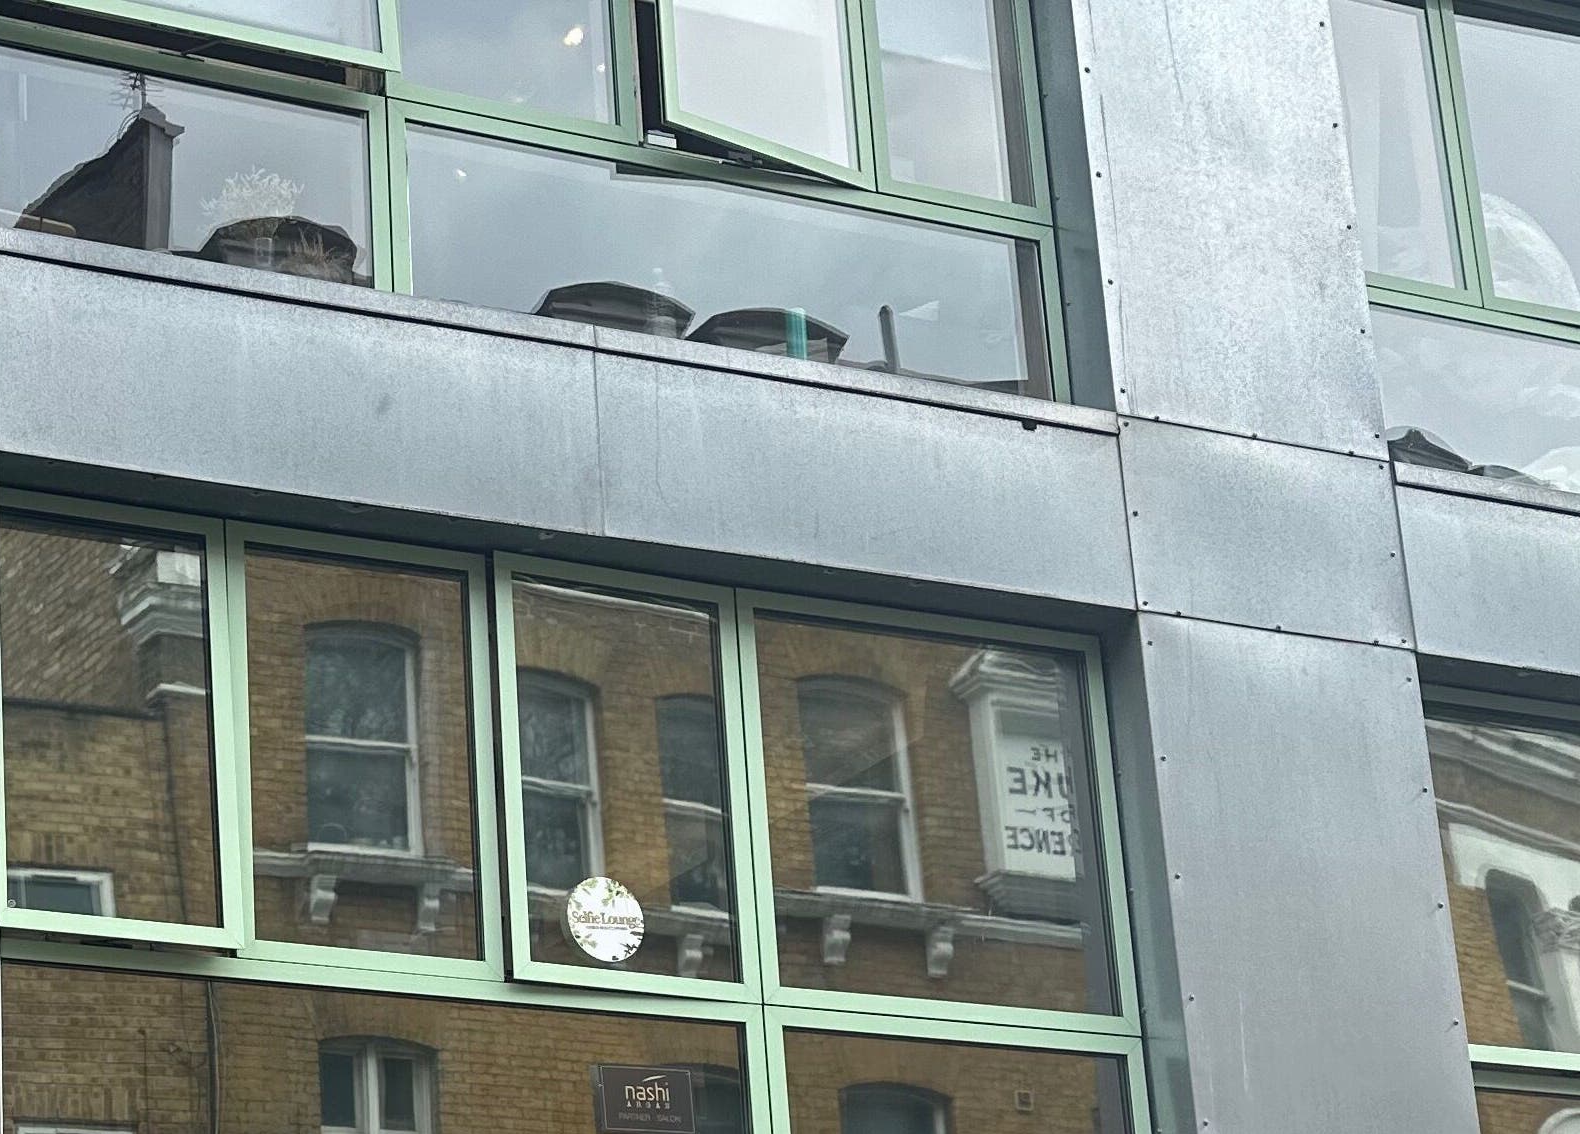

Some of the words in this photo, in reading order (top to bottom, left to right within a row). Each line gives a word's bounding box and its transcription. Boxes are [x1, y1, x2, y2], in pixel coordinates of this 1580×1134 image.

[571, 910, 601, 924] Selfie
[600, 912, 642, 930] Lounge
[625, 1081, 670, 1102] nashi
